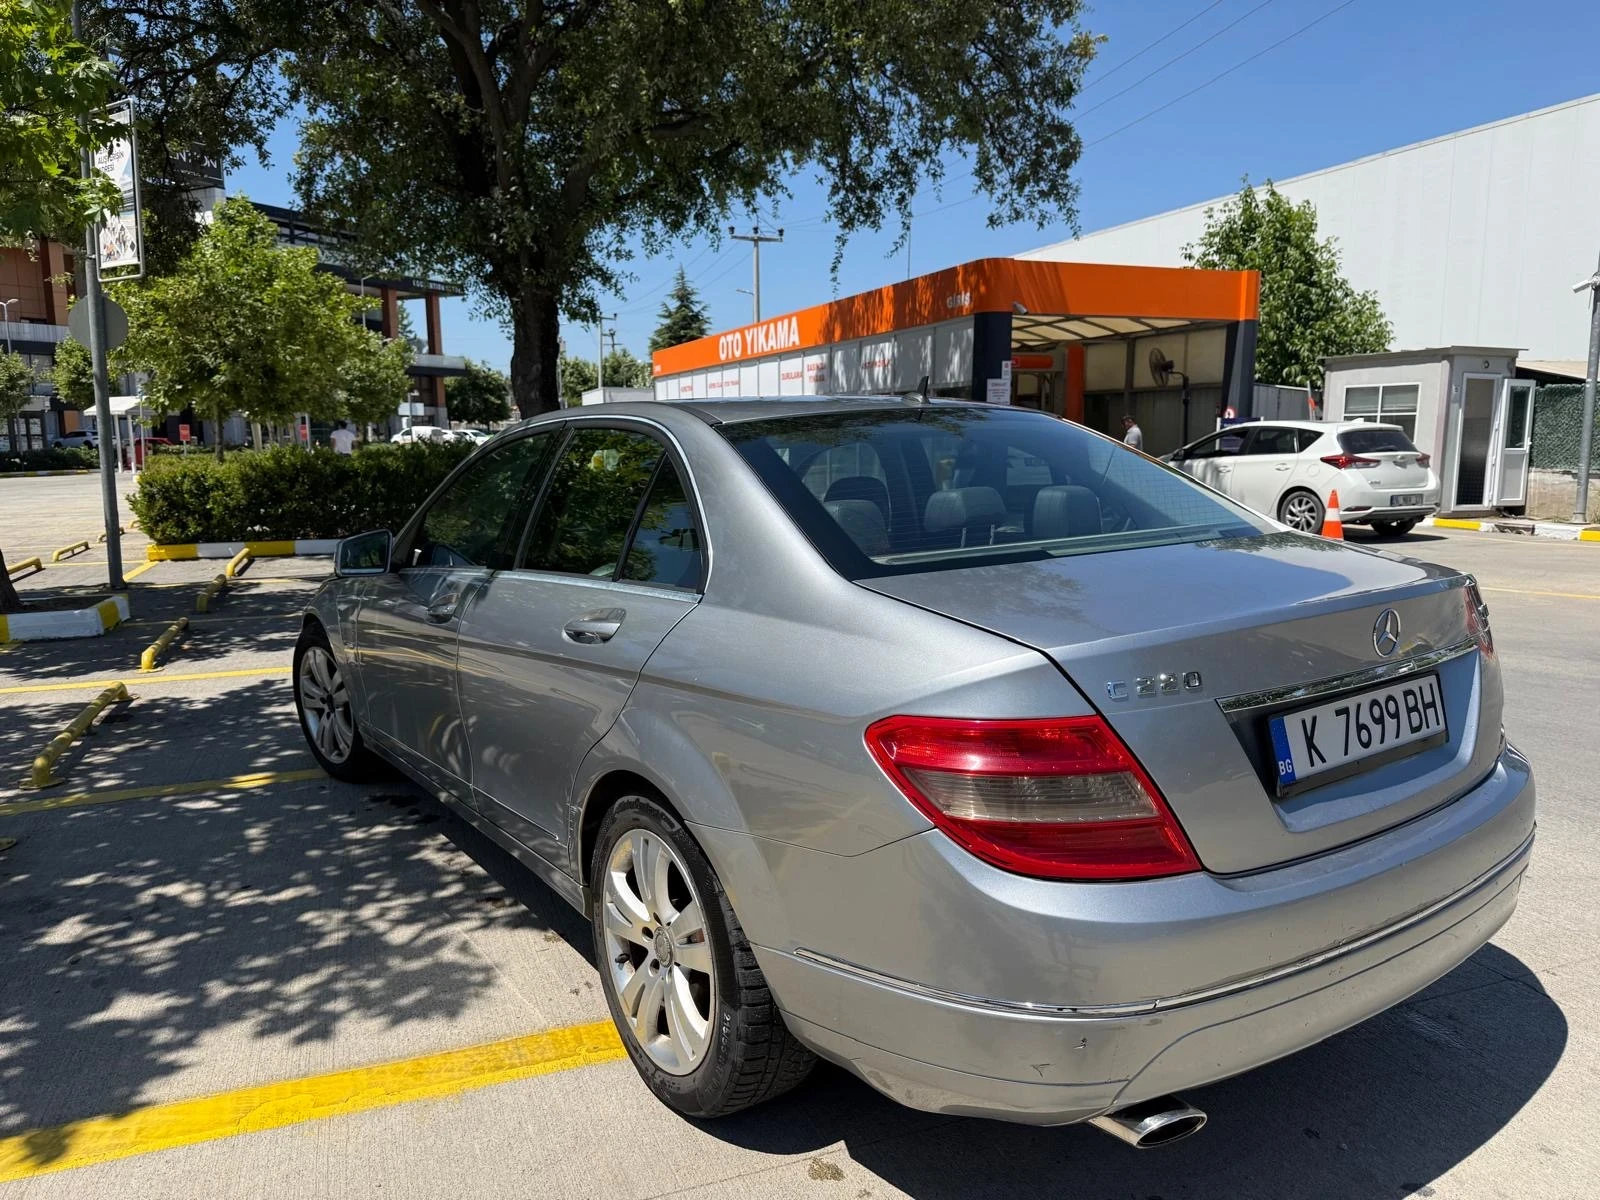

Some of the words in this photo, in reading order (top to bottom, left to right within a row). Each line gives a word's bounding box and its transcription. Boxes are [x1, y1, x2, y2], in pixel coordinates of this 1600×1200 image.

[719, 331, 742, 361] OTO
[744, 316, 800, 355] YIKAMA
[1106, 680, 1128, 699] C
[1135, 671, 1202, 695] 220
[1301, 715, 1327, 767] K
[1278, 758, 1293, 776] BG
